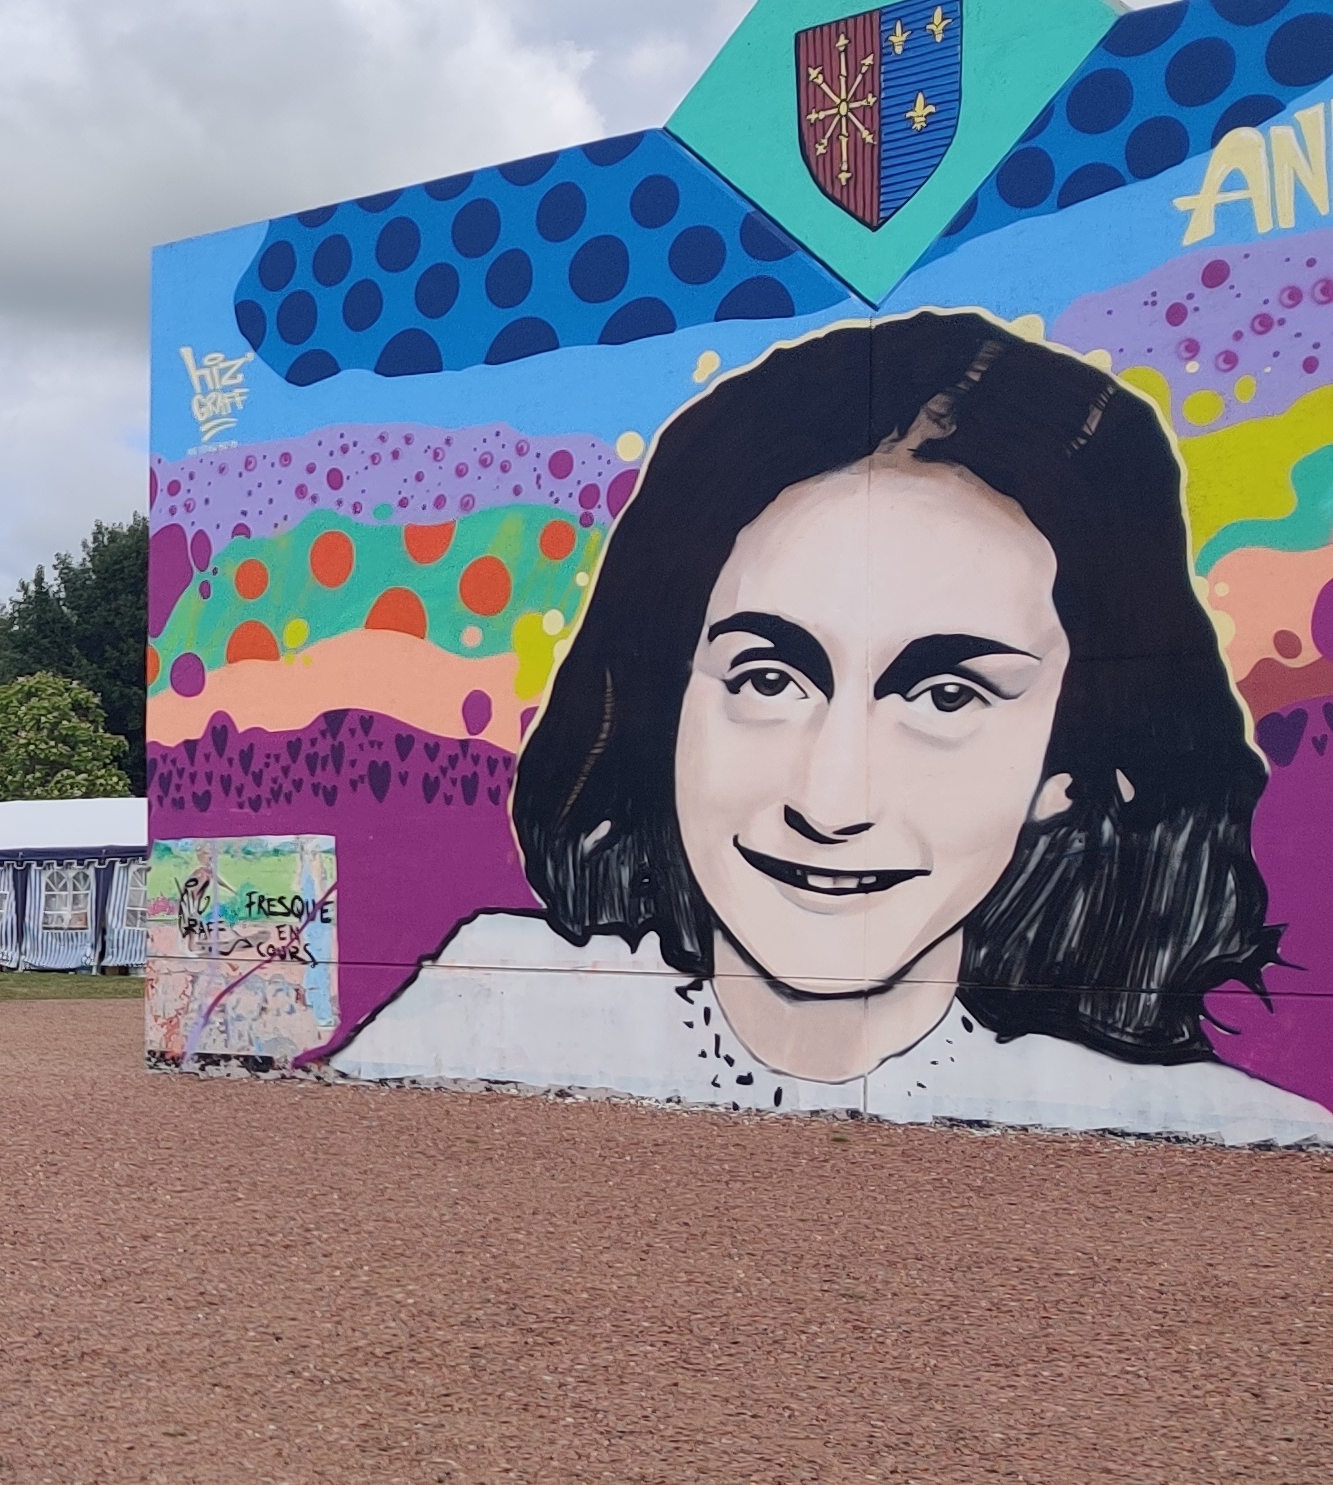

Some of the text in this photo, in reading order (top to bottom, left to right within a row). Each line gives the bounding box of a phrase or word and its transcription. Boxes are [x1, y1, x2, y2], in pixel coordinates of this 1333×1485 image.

[1172, 98, 1333, 246] AN
[245, 890, 335, 924] FRESQUE
[275, 923, 301, 943] EN
[256, 941, 319, 968] COURS
